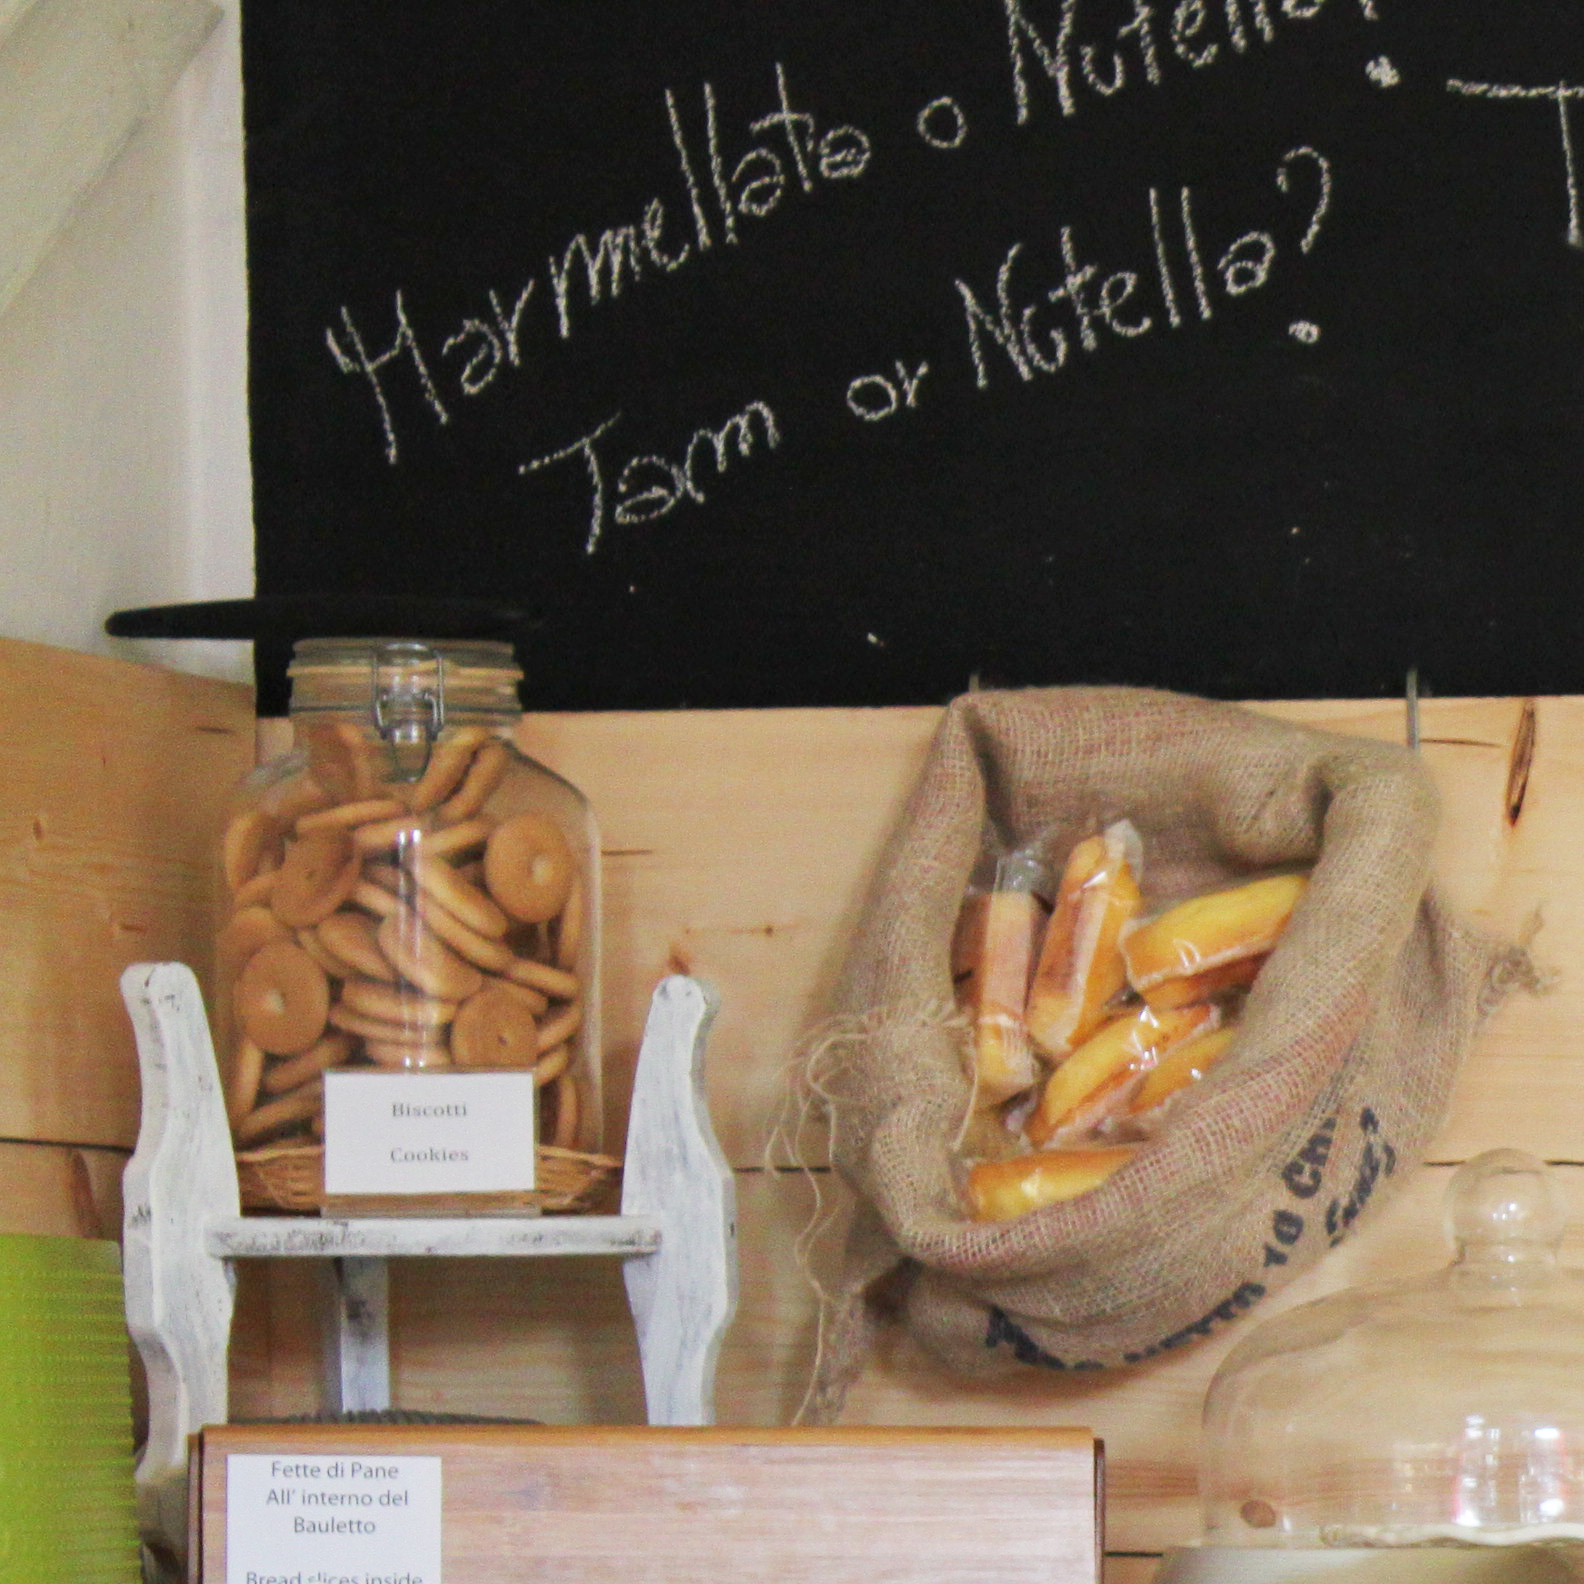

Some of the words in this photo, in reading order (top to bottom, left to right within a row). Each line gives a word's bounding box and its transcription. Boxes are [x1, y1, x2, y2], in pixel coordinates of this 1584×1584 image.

[919, 97, 966, 147] o
[847, 362, 927, 420] or
[954, 146, 1330, 387] Nutella?
[392, 1103, 468, 1118] Biscotti
[390, 1147, 470, 1163] Cookies
[271, 1461, 321, 1479] Fette
[327, 1461, 345, 1479] di
[350, 1462, 399, 1480] Pane
[302, 1490, 373, 1507] interno
[378, 1490, 409, 1507] del
[294, 1516, 376, 1535] Bauletto
